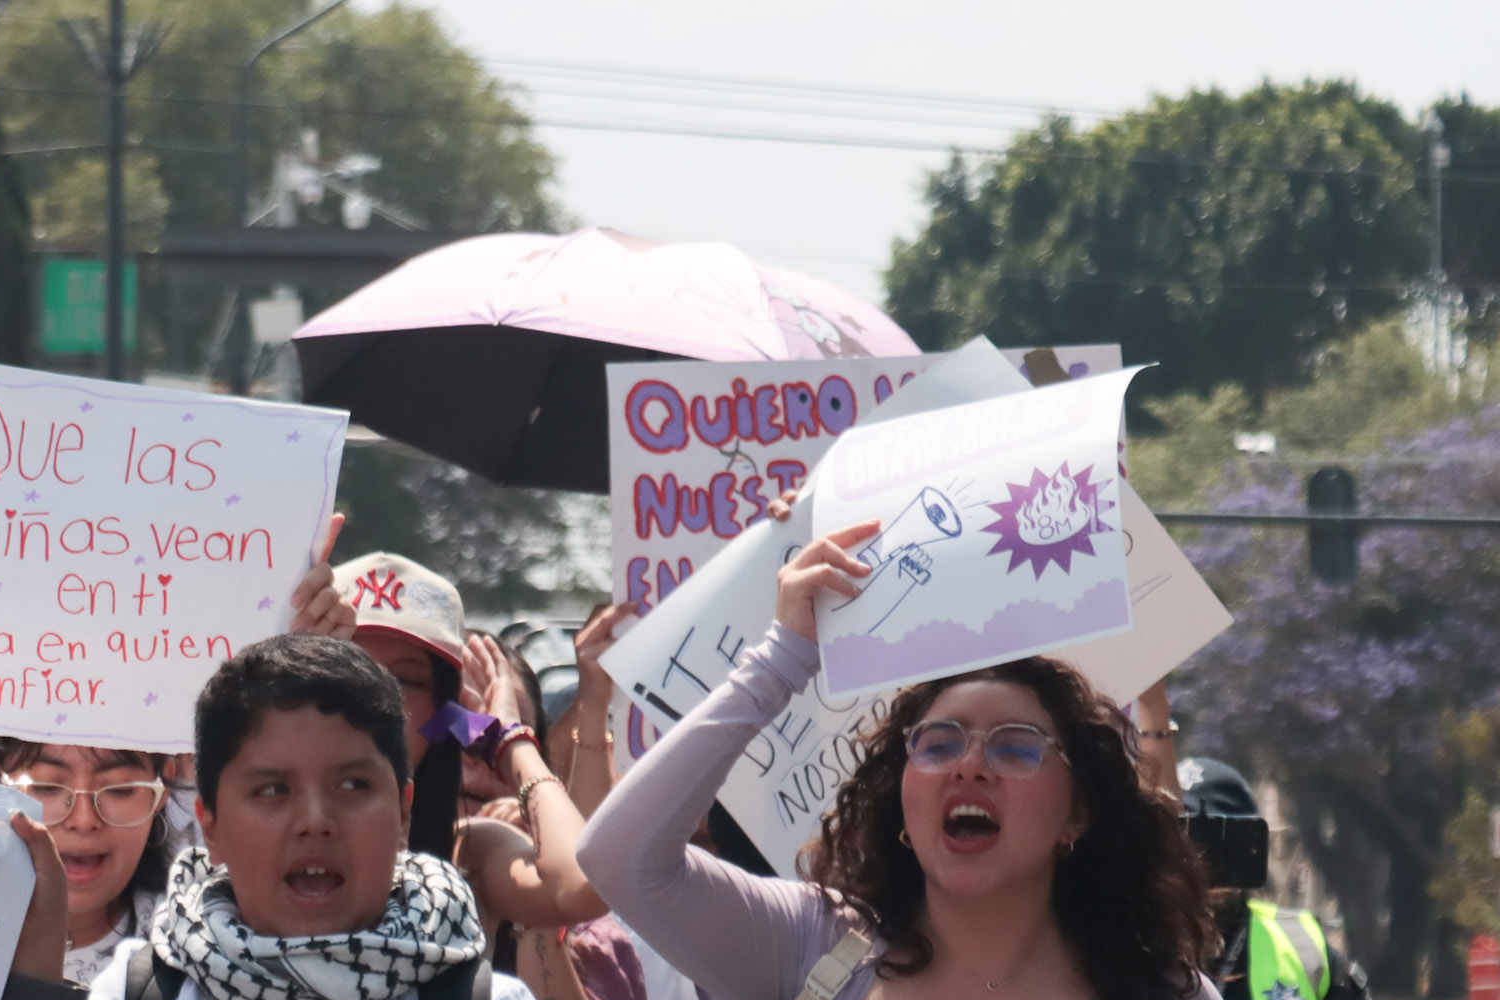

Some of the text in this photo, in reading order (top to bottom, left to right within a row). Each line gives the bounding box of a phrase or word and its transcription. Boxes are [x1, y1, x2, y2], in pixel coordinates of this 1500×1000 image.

[125, 427, 222, 491] las
[150, 523, 273, 568] vean
[1037, 514, 1073, 540] 8M
[57, 573, 172, 615] en ti
[36, 632, 86, 663] en
[107, 629, 234, 663] quien
